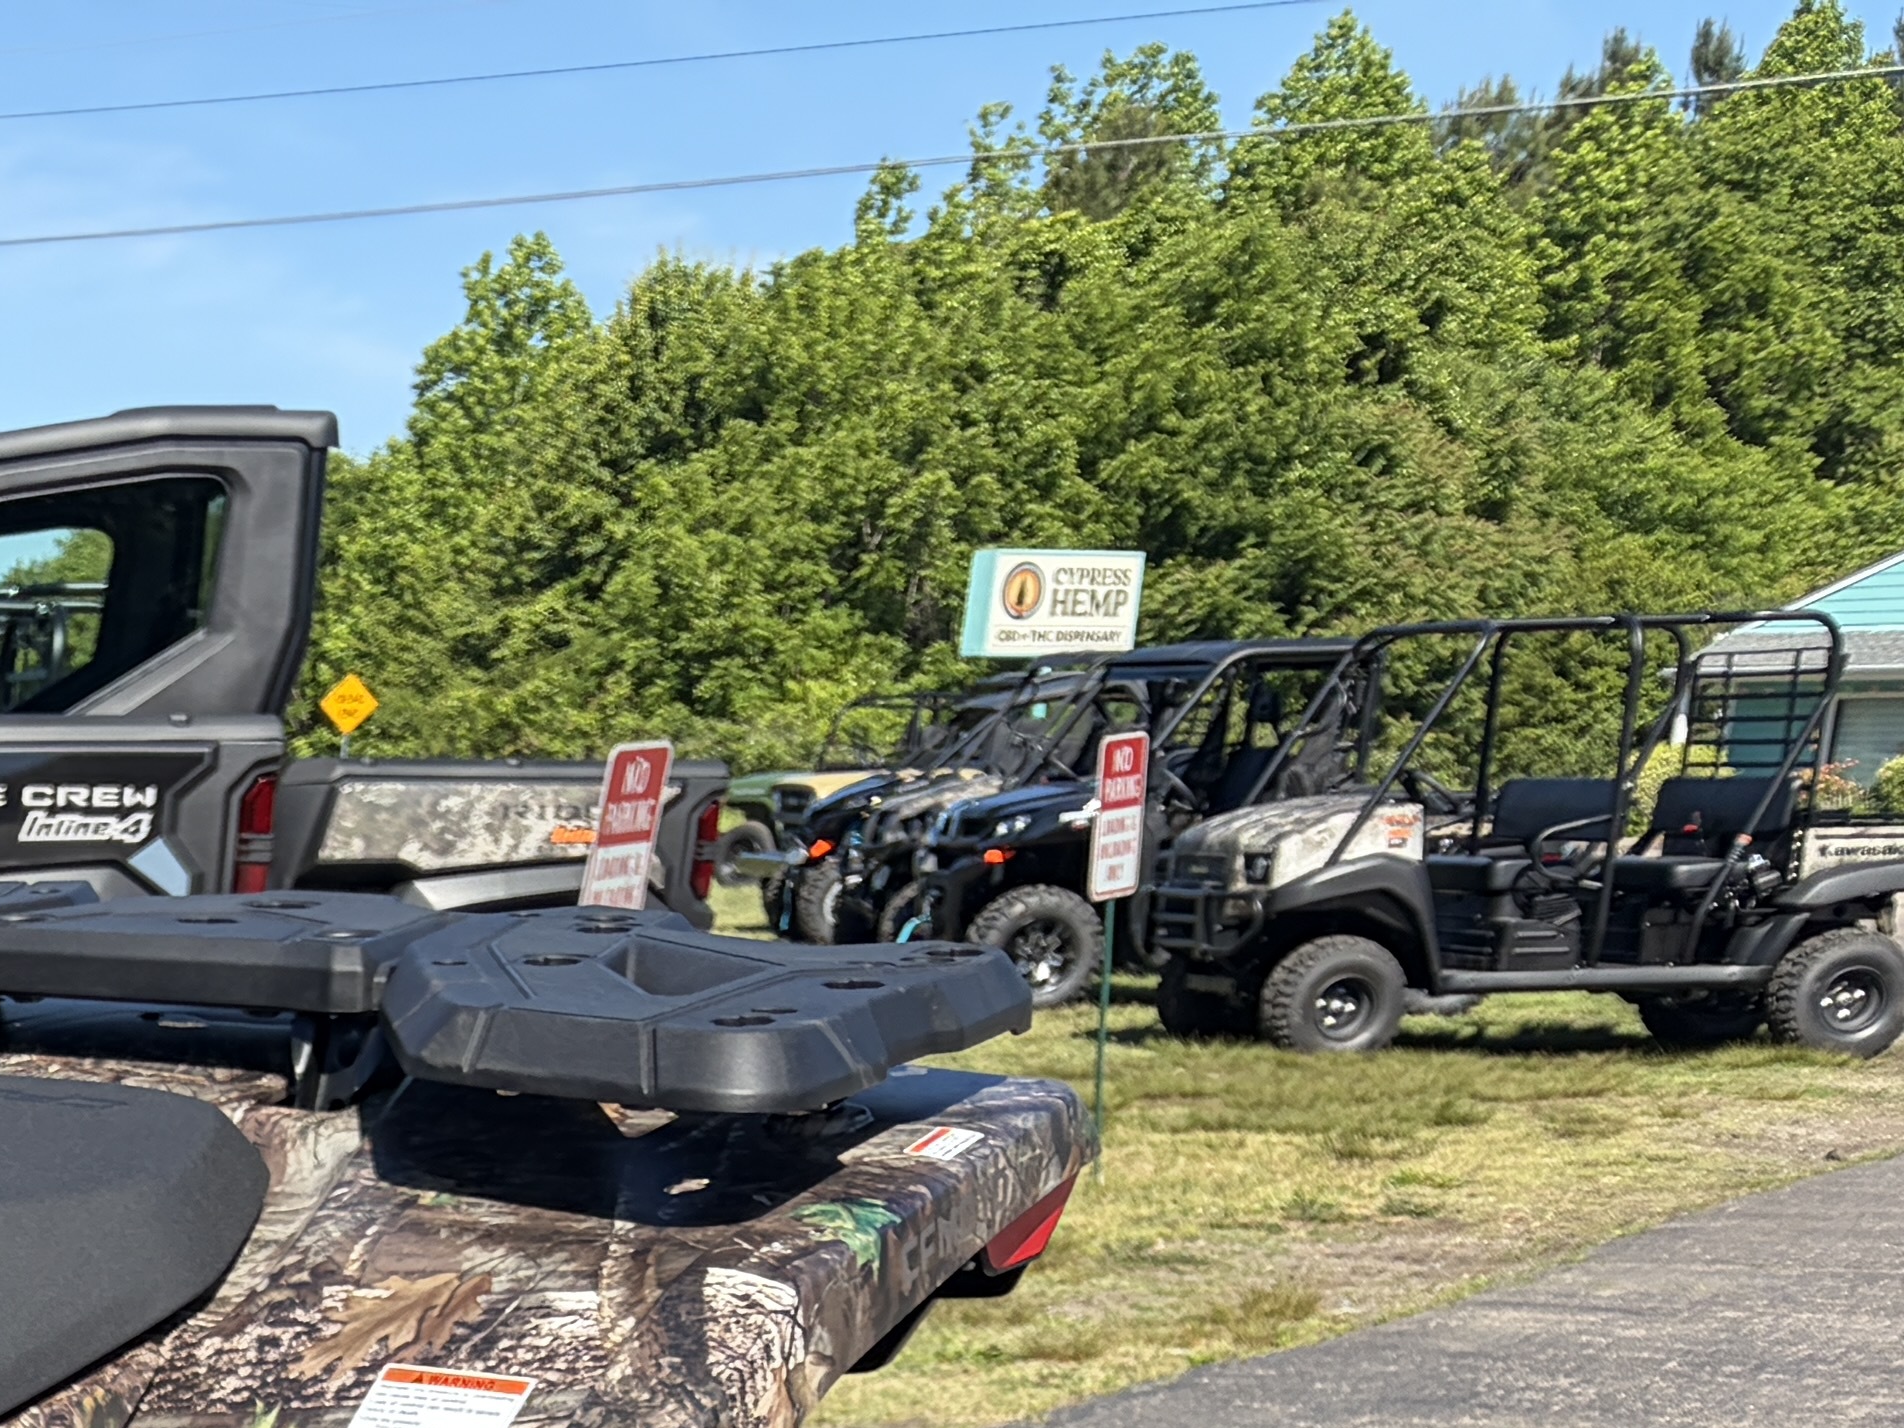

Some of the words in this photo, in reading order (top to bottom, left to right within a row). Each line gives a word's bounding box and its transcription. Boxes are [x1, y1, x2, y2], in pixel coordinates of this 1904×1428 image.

[1052, 567, 1132, 587] CYPRESS
[1048, 588, 1129, 618] HEMP
[1056, 629, 1121, 643] DISPENSARY
[1112, 745, 1134, 775] NO
[21, 783, 159, 808] CREW
[426, 1376, 497, 1391] WARNING
